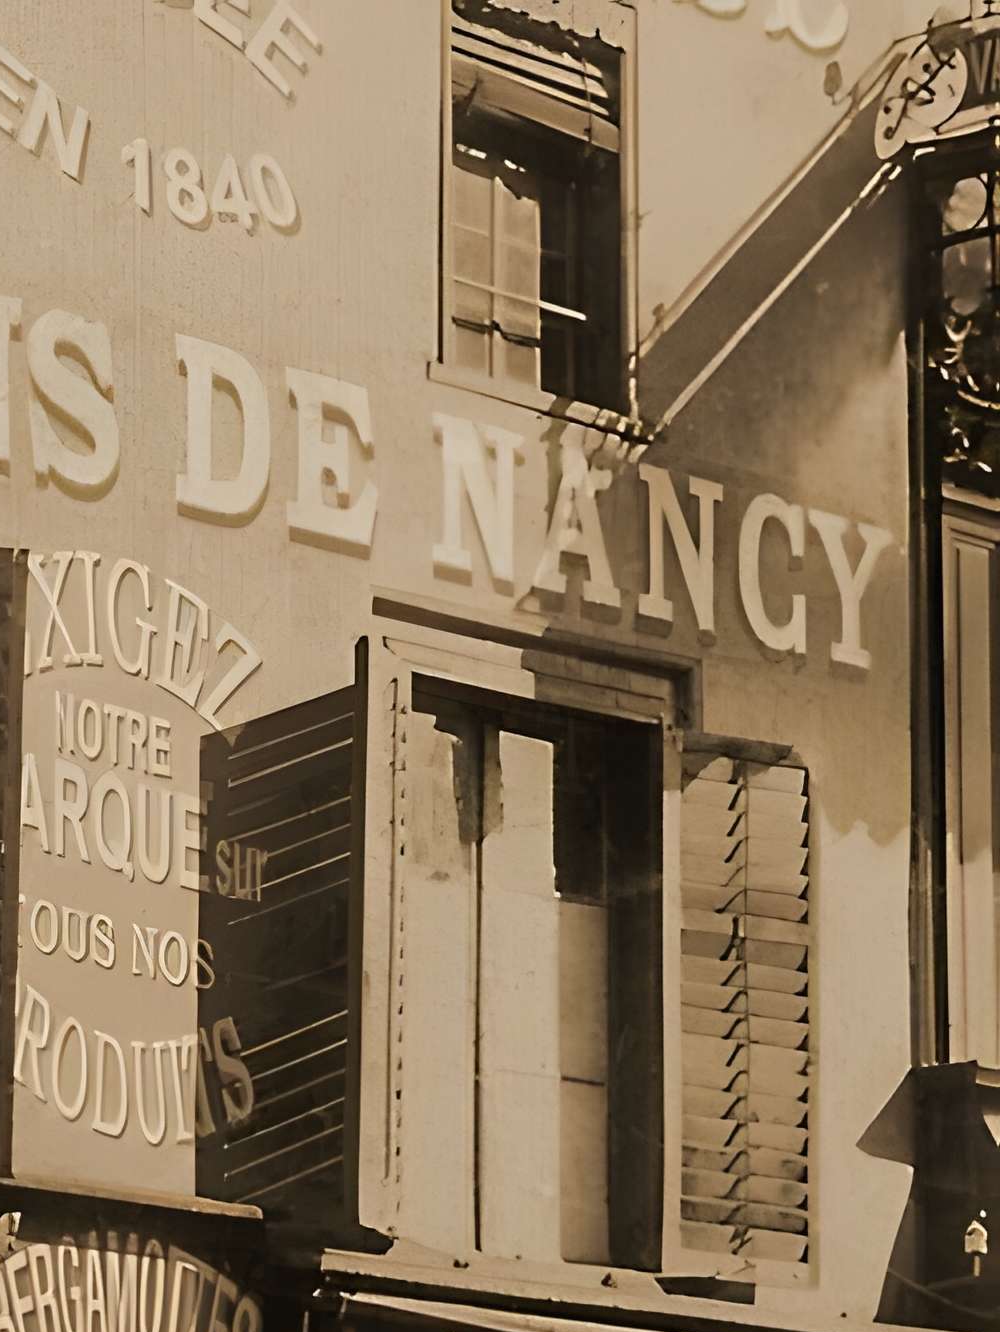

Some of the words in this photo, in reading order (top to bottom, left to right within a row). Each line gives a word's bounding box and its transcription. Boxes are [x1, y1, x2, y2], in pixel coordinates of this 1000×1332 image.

[120, 137, 302, 237] 1840
[174, 332, 379, 560] DE
[431, 410, 894, 669] NANCY
[22, 550, 263, 732] XIGEZ
[55, 690, 173, 779] NOTRE
[19, 752, 214, 892] ARQUE
[17, 893, 116, 969] OUS
[131, 922, 216, 990] NOS
[13, 974, 254, 1145] RODUITS
